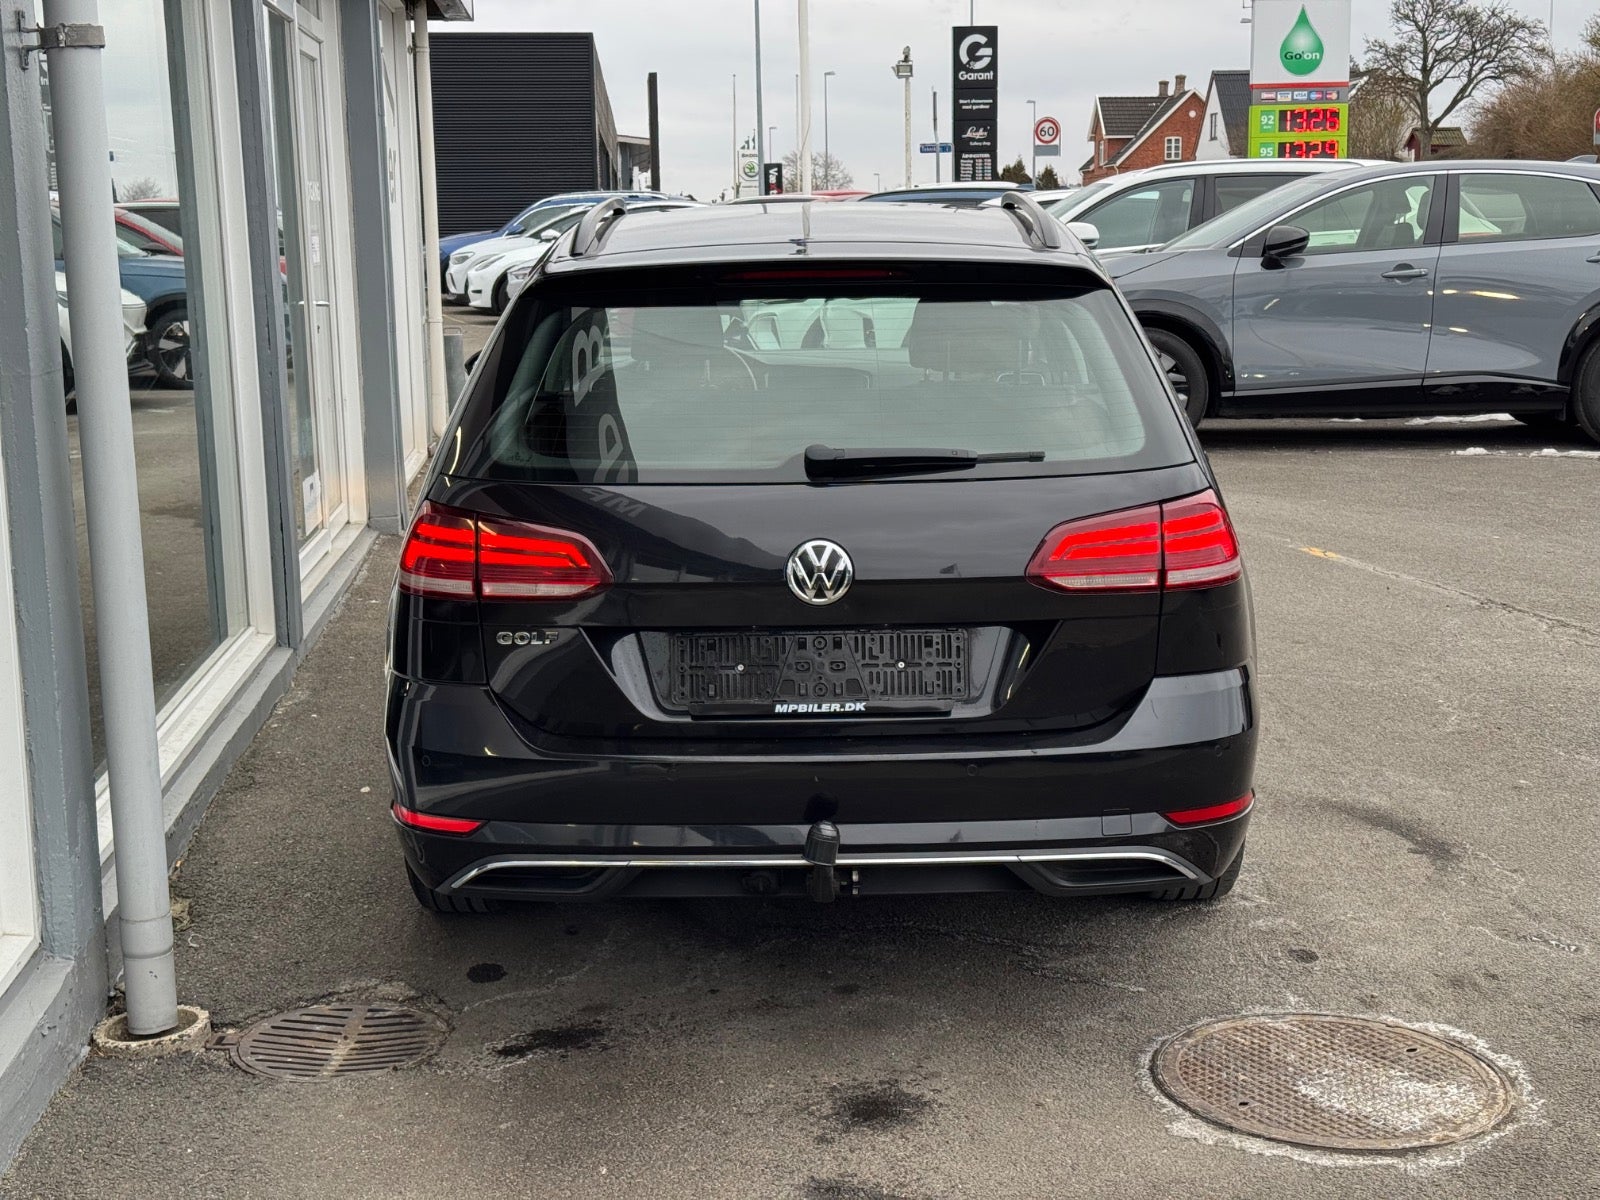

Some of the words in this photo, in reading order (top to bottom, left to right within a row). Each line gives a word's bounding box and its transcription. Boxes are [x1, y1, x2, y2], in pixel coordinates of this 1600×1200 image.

[959, 71, 994, 80] Garant
[1261, 115, 1275, 125] 92
[1039, 126, 1055, 137] 60
[1260, 147, 1274, 157] 95
[496, 631, 559, 645] GOLF
[774, 702, 867, 713] MPBILER.DK
